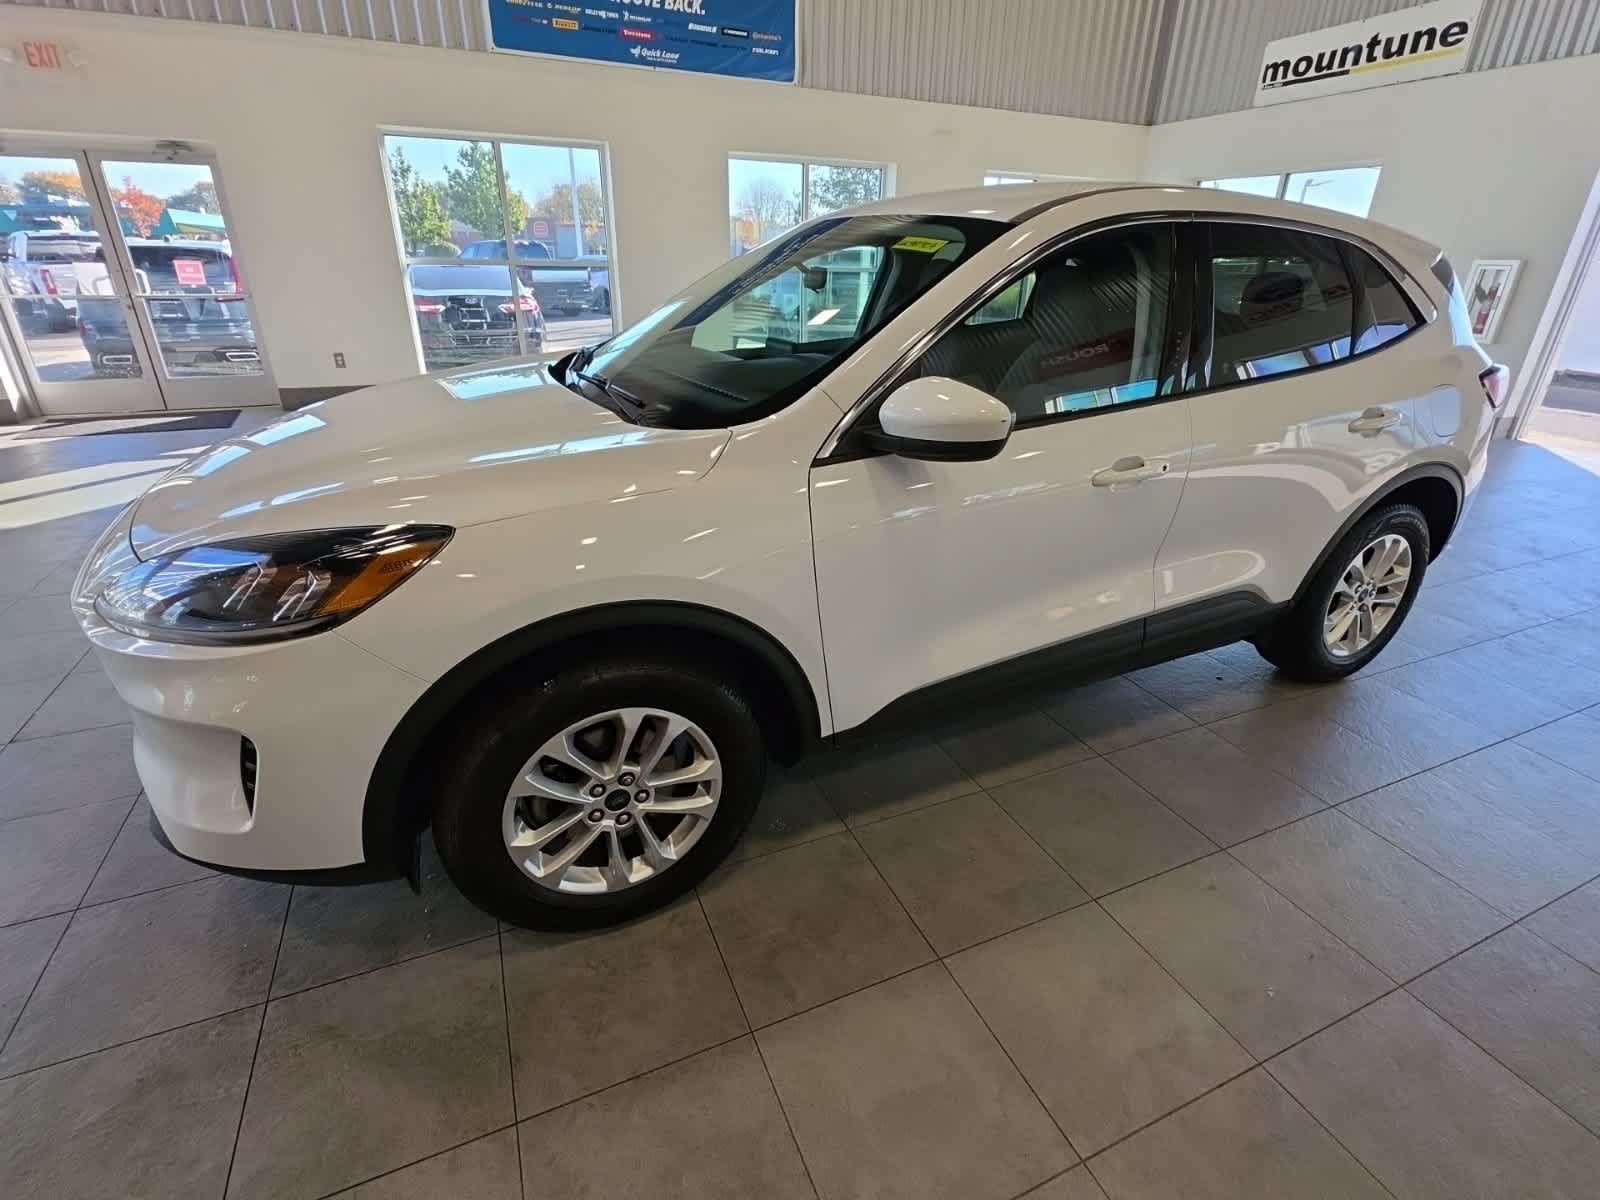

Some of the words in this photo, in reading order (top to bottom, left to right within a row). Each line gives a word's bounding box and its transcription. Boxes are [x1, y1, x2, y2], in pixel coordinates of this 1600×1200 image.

[663, 0, 706, 15] BACK.
[22, 40, 62, 70] EXIT
[641, 47, 661, 57] Quick
[1262, 20, 1469, 84] mountune
